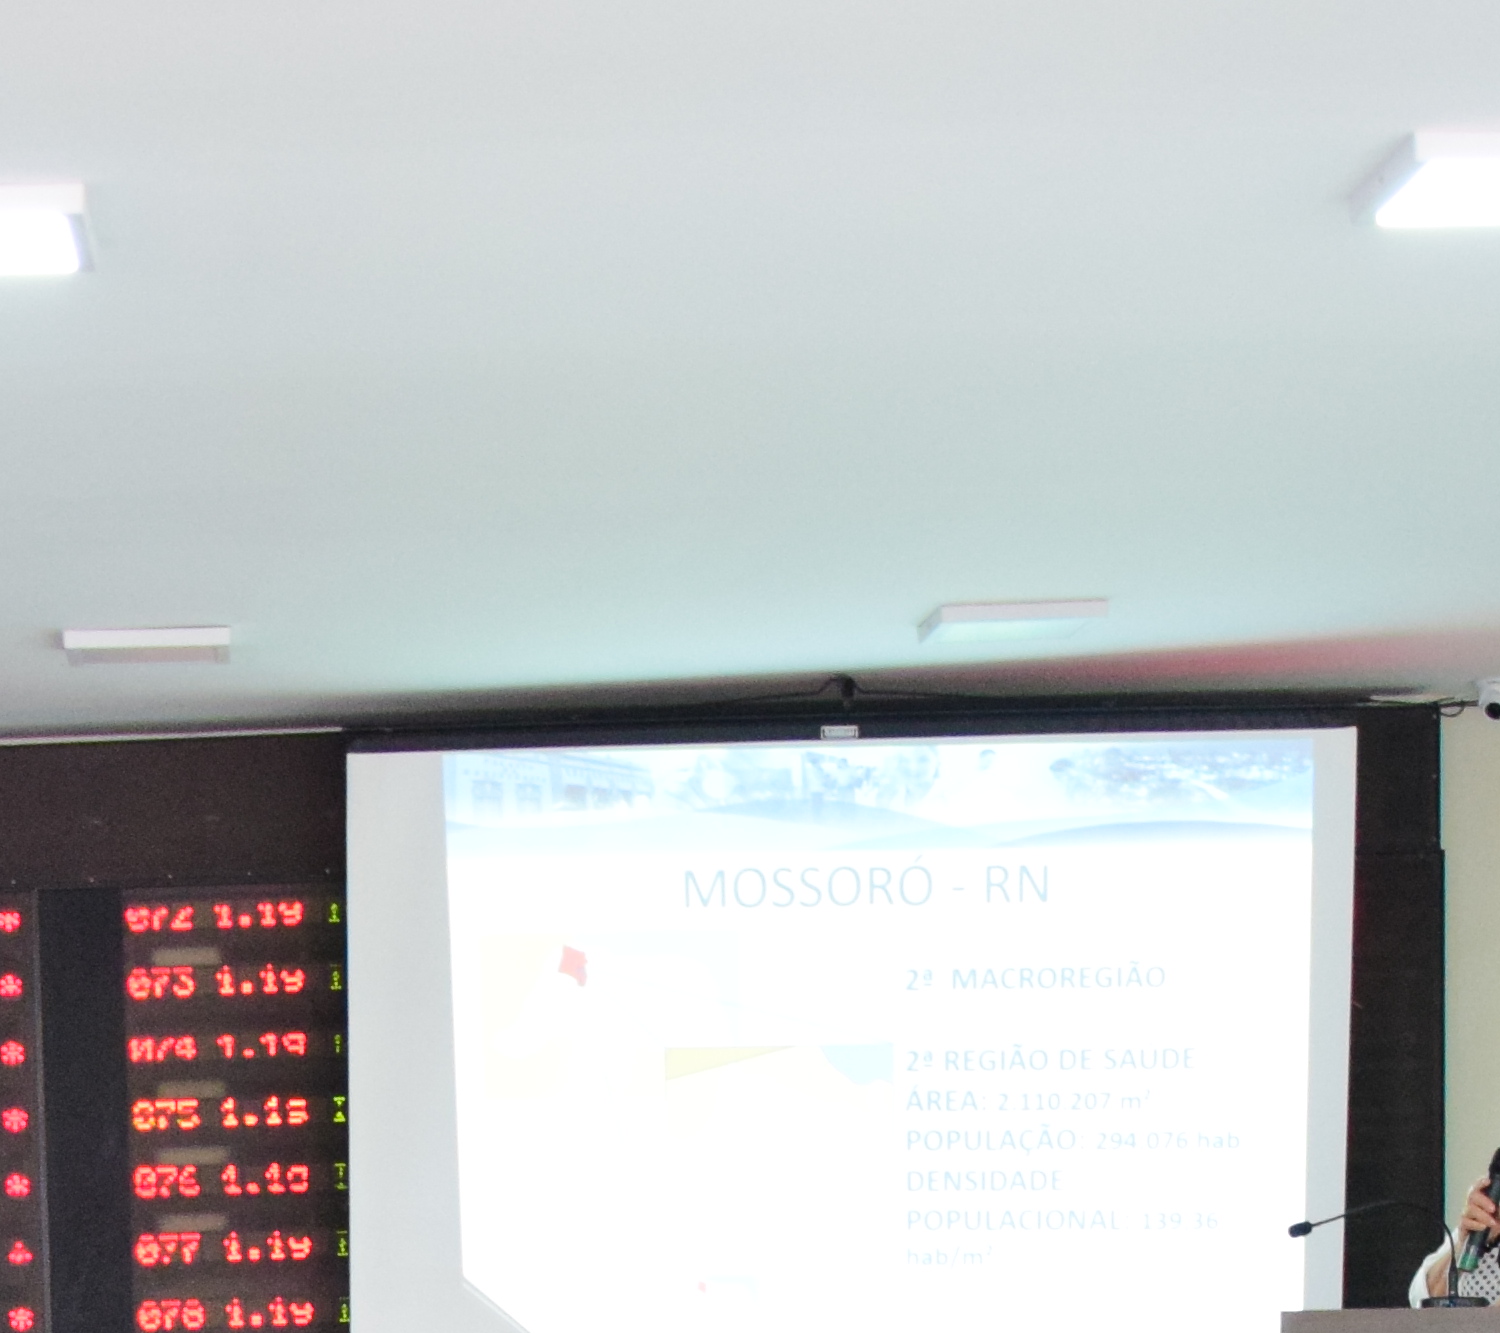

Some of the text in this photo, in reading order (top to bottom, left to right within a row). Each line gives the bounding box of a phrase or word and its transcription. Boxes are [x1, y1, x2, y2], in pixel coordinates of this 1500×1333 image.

[682, 854, 934, 909] MOSSORÓ
[985, 865, 1051, 904] RN
[951, 961, 1167, 990] MACROREGIÃO
[944, 1044, 1049, 1072] REGIÃO
[1059, 1048, 1091, 1071] DE
[1197, 1132, 1240, 1149] hab
[906, 1170, 1063, 1192] DENSIDADE
